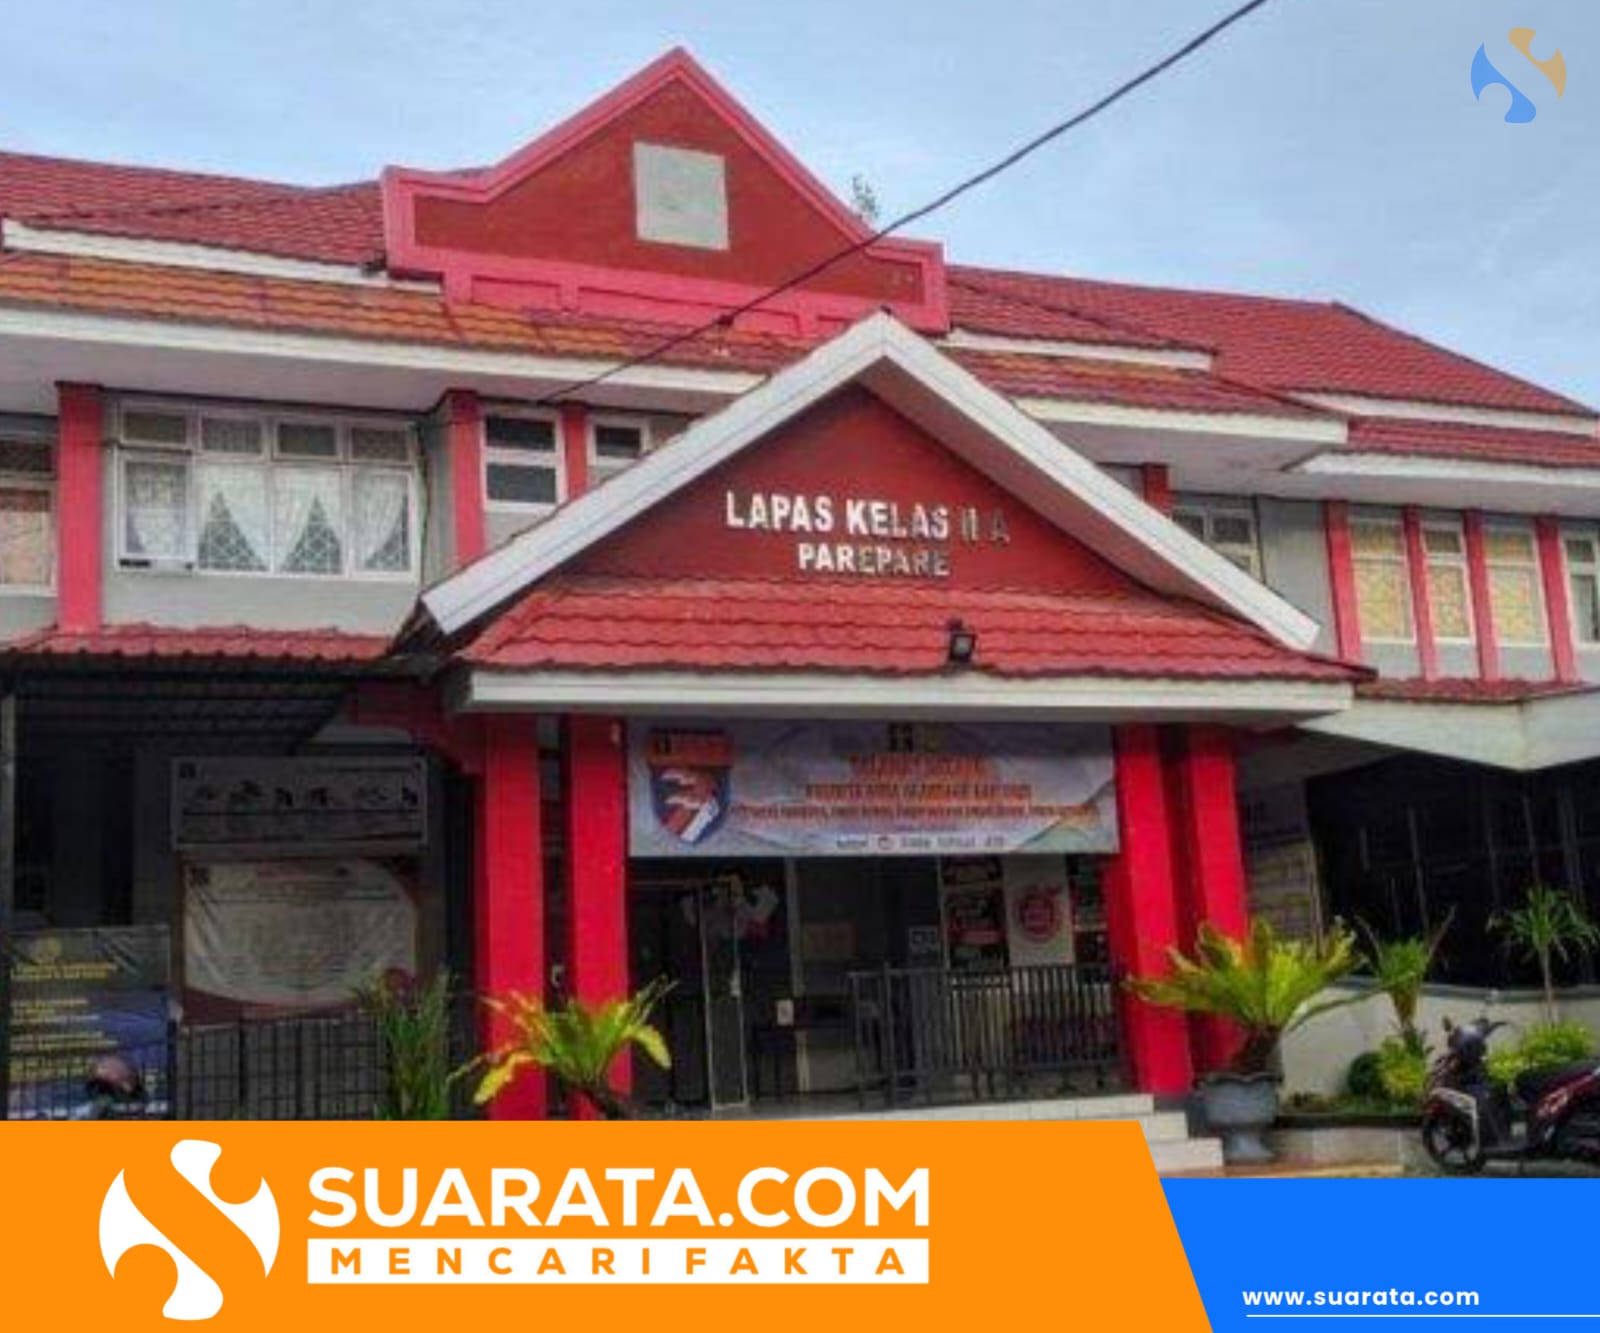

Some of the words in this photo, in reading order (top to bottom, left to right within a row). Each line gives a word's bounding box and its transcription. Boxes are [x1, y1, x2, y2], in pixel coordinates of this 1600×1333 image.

[726, 490, 834, 532] LAPAS
[846, 498, 949, 540] KELAS
[961, 506, 978, 542] II
[989, 507, 1011, 544] A
[798, 542, 950, 576] PAREPARE
